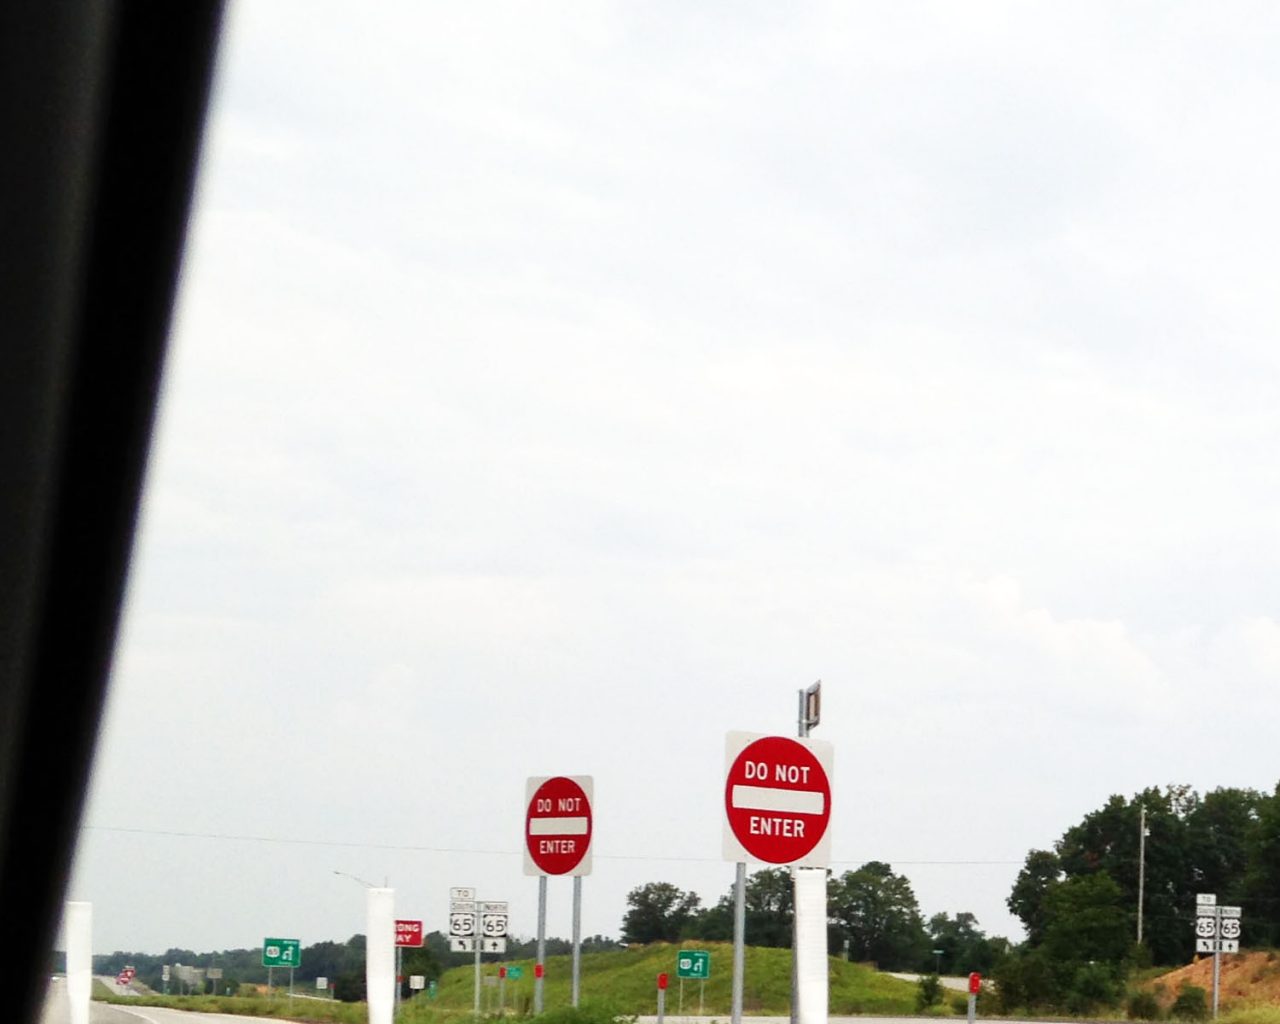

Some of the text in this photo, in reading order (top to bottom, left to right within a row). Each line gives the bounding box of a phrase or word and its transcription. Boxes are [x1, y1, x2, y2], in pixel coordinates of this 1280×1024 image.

[745, 761, 810, 784] DO NOT
[537, 798, 581, 813] DO NOT
[750, 816, 805, 838] ENTER
[540, 840, 575, 854] ENTER
[457, 889, 469, 897] TO
[396, 923, 420, 932] ONG
[452, 918, 472, 932] 65
[486, 919, 505, 933] 65
[1199, 921, 1213, 934] 65
[1223, 922, 1239, 935] 65
[396, 934, 412, 943] AY
